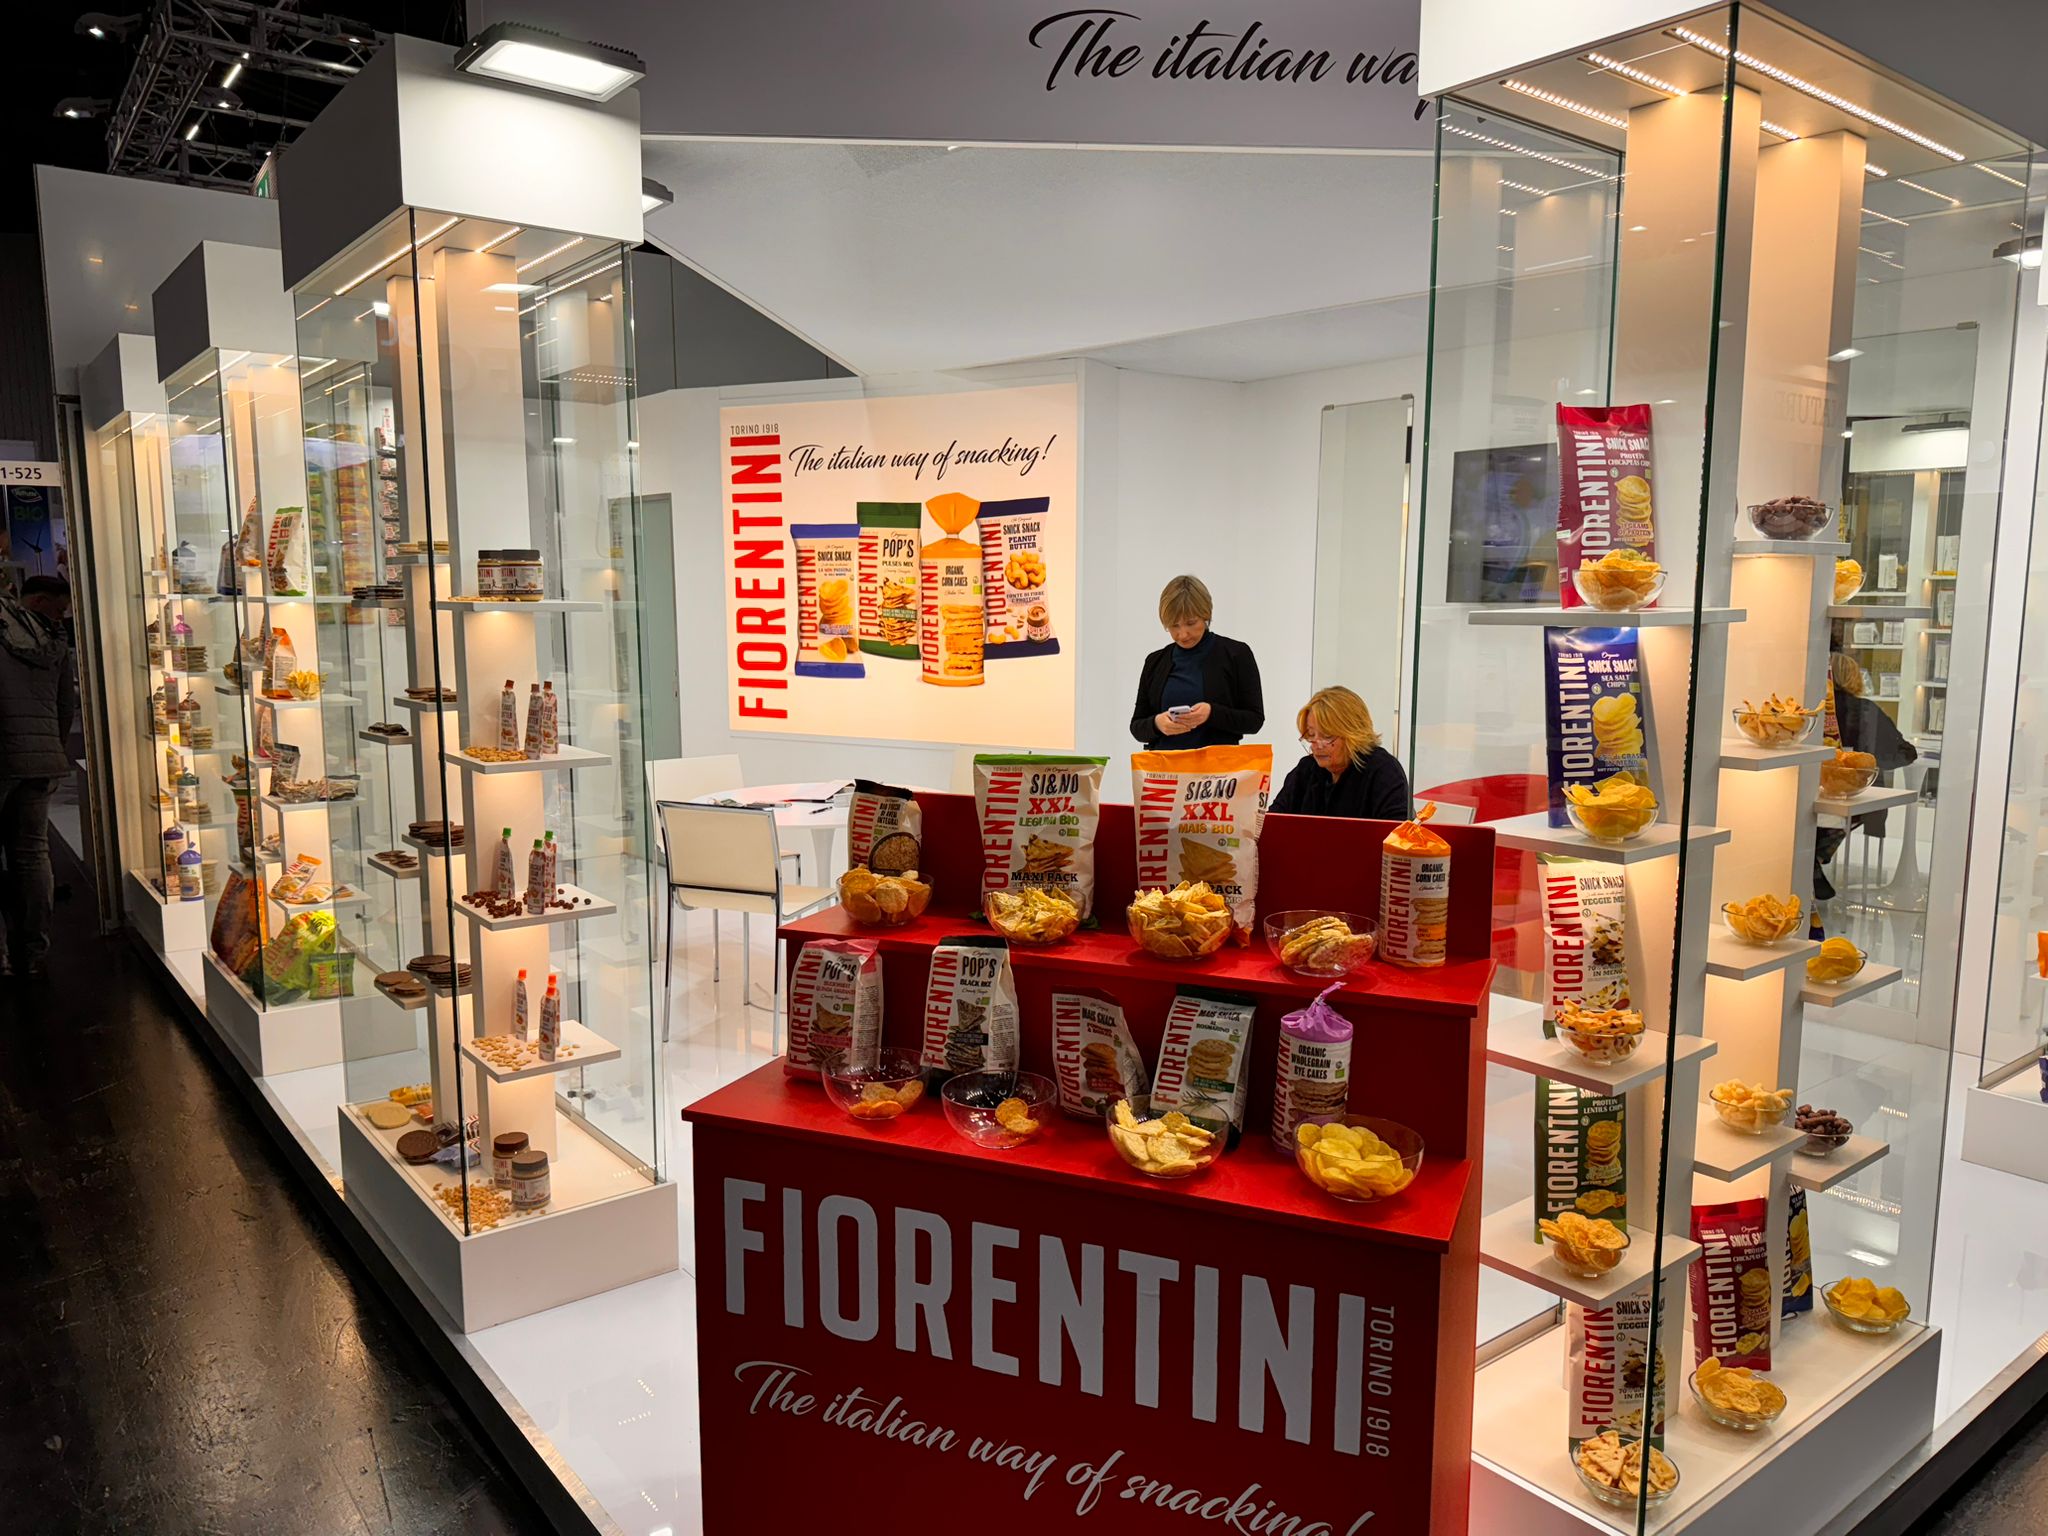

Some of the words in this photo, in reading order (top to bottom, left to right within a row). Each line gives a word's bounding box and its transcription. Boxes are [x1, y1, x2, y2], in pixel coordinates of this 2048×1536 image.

[1029, 9, 1144, 91] The
[1152, 20, 1336, 83] italian
[731, 424, 759, 435] TORINO
[763, 423, 779, 433] 1918
[1605, 437, 1628, 451] SNICK
[789, 444, 824, 477] The
[827, 445, 887, 470] italian
[891, 451, 929, 480] way
[933, 440, 957, 480] of
[954, 434, 1057, 476] snacking!
[0, 467, 42, 480] 1-525
[1573, 434, 1612, 558] IORENTINI
[1003, 525, 1020, 535] SNICK
[1021, 522, 1041, 533] SNACK
[883, 538, 914, 558] POP'S
[1008, 534, 1037, 544] PEANUT
[1009, 542, 1037, 550] BUTTER
[818, 551, 834, 561] SNICK
[835, 551, 852, 561] SNACK
[730, 434, 788, 719] FIORENTINI
[945, 565, 964, 575] ORGANIC
[980, 522, 1008, 628] FIORENTINI
[858, 535, 879, 638] FIORENTINI
[942, 577, 954, 586] CORN
[954, 577, 968, 586] CAKES
[797, 548, 819, 651] FIORENTINI
[921, 564, 940, 675] FIORENTINI
[1588, 660, 1612, 674] SNICK
[1612, 658, 1638, 673] SNACK
[1030, 773, 1079, 796] SI&NO
[1185, 778, 1238, 801] SI&NO
[1027, 796, 1075, 815] XXL
[1180, 801, 1234, 821] XXL
[1018, 816, 1057, 827] LEGUMI
[1059, 814, 1079, 826] BIO
[1178, 823, 1207, 834] MAIS
[1211, 823, 1235, 834] BIO
[983, 772, 1024, 889] ORENTINI
[1011, 871, 1045, 881] MAXI
[1047, 872, 1079, 882] PACK
[1421, 863, 1443, 873] ORGANIC
[1415, 873, 1432, 883] CORN
[1432, 873, 1446, 883] CAKES
[1580, 878, 1602, 891] SNICK
[1603, 875, 1625, 889] SNACK
[1386, 860, 1411, 959] FIORENTINI
[1581, 896, 1613, 906] VEGGIE
[1546, 876, 1585, 1006] FIORENTINI
[822, 960, 858, 982] POP'S
[961, 955, 997, 979] POP'S
[959, 979, 980, 987] BLACK
[789, 954, 824, 1066] FIORENTINI
[923, 951, 959, 1066] FIORENTINI
[1096, 1010, 1117, 1028] SNACK
[1196, 1023, 1230, 1034] ROSMARINO
[1056, 1000, 1082, 1107] FIORENTINI
[1154, 1000, 1201, 1105] FIORENTINI
[1298, 1044, 1327, 1058] ORGANIC
[1291, 1053, 1332, 1069] WHOLEGRAIN
[1294, 1065, 1305, 1076] RYE
[1306, 1068, 1328, 1080] CAKES
[1271, 1036, 1291, 1144] FIORENTINI
[1583, 1106, 1608, 1114] LENTILS
[1608, 1103, 1624, 1112] CHIPS
[1592, 1098, 1618, 1107] PROTEIN
[1547, 1081, 1579, 1213] FIORENTINI
[1729, 1235, 1751, 1248] SNICK
[1702, 1233, 1738, 1358] FIORENTINI
[724, 1177, 1366, 1456] FIORENTINI
[1616, 1300, 1642, 1316] SNICK
[1367, 1305, 1395, 1397] TORINO
[734, 1360, 818, 1415] The
[822, 1387, 961, 1452] italian
[967, 1437, 1057, 1501] way
[1066, 1450, 1125, 1517] of
[1366, 1406, 1391, 1458] 1918
